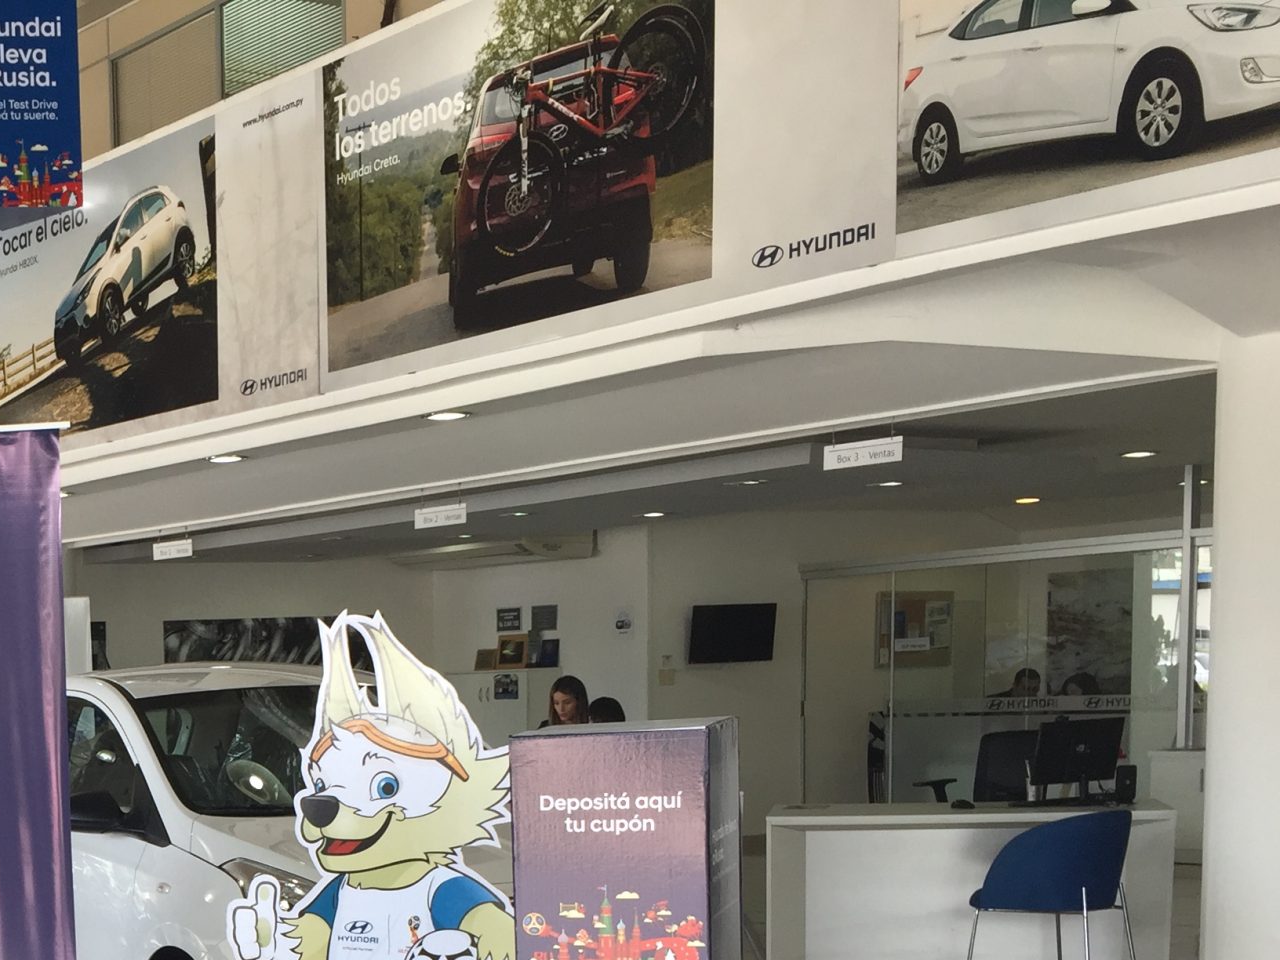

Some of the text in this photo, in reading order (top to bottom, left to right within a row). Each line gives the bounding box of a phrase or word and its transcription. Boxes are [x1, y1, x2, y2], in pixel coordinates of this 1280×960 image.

[9, 99, 29, 109] Test
[32, 99, 58, 109] Drive
[334, 77, 401, 122] Todos
[11, 112, 21, 120] tu
[23, 111, 59, 120] suerte.
[335, 90, 472, 161] los terrenos.
[336, 154, 401, 185] Hyundai Creta.
[35, 218, 48, 243] el
[50, 209, 88, 237] cielo.
[789, 222, 875, 259] HYUNDAI
[260, 368, 307, 390] HYUNDAI
[836, 449, 896, 464] Box 3 Ventas
[539, 790, 682, 814] Depositá aquí
[564, 814, 655, 836] tu cupón
[337, 935, 379, 944] HYUNDAI
